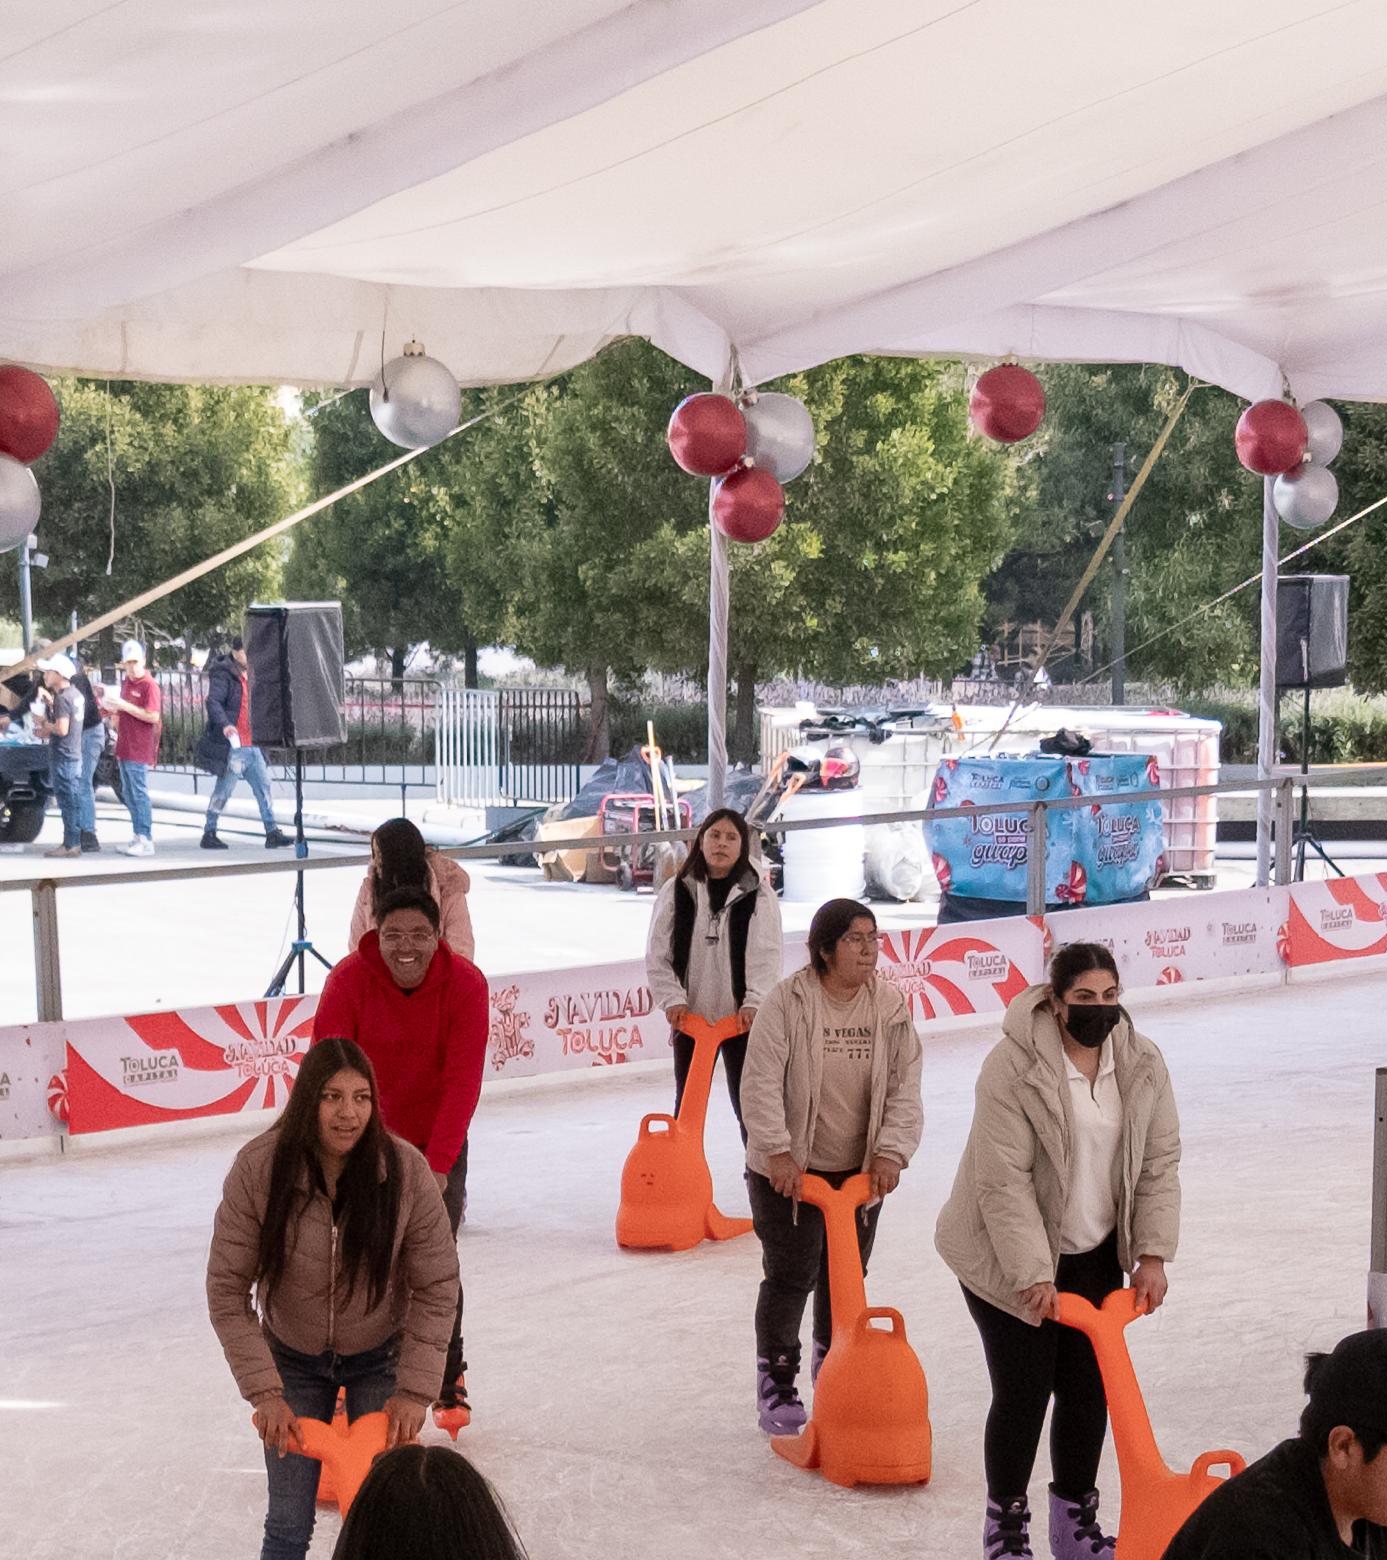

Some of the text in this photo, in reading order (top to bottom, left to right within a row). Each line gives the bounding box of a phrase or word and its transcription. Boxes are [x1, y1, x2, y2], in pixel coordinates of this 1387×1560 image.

[972, 815, 1033, 835] TOLUC
[971, 844, 1029, 868] guap
[544, 986, 654, 1028] NAVIDAD
[556, 1023, 644, 1056] TOLUCA
[834, 1027, 872, 1038] VEGAS
[847, 1048, 871, 1060] 777
[120, 1055, 179, 1074] TOLUCA
